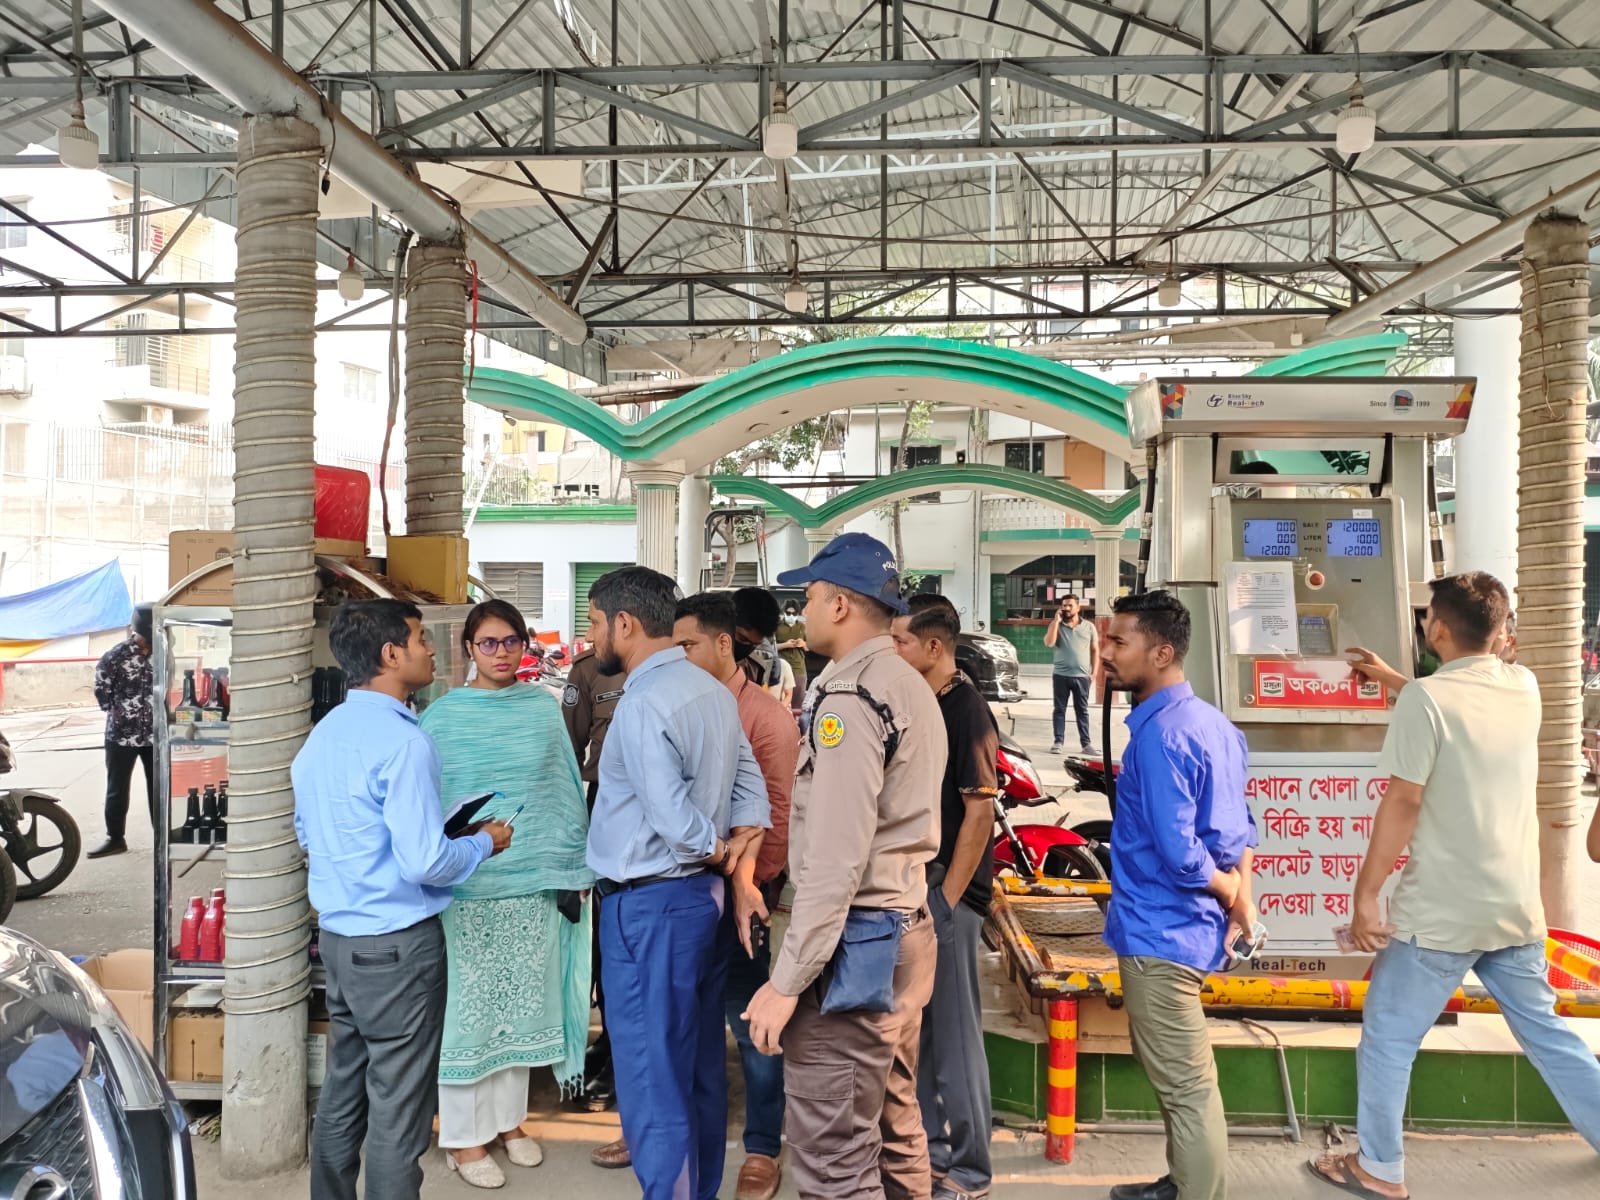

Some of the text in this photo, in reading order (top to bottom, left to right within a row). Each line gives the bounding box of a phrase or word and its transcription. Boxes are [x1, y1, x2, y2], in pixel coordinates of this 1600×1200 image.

[1245, 775, 1392, 801] এখানে খোলা তে
[1263, 808, 1373, 840] বিক্রি হয় না
[1319, 854, 1363, 882] ছাড়া
[1258, 891, 1350, 916] দেওয়া হয়
[1250, 958, 1327, 972] Real-Tech
